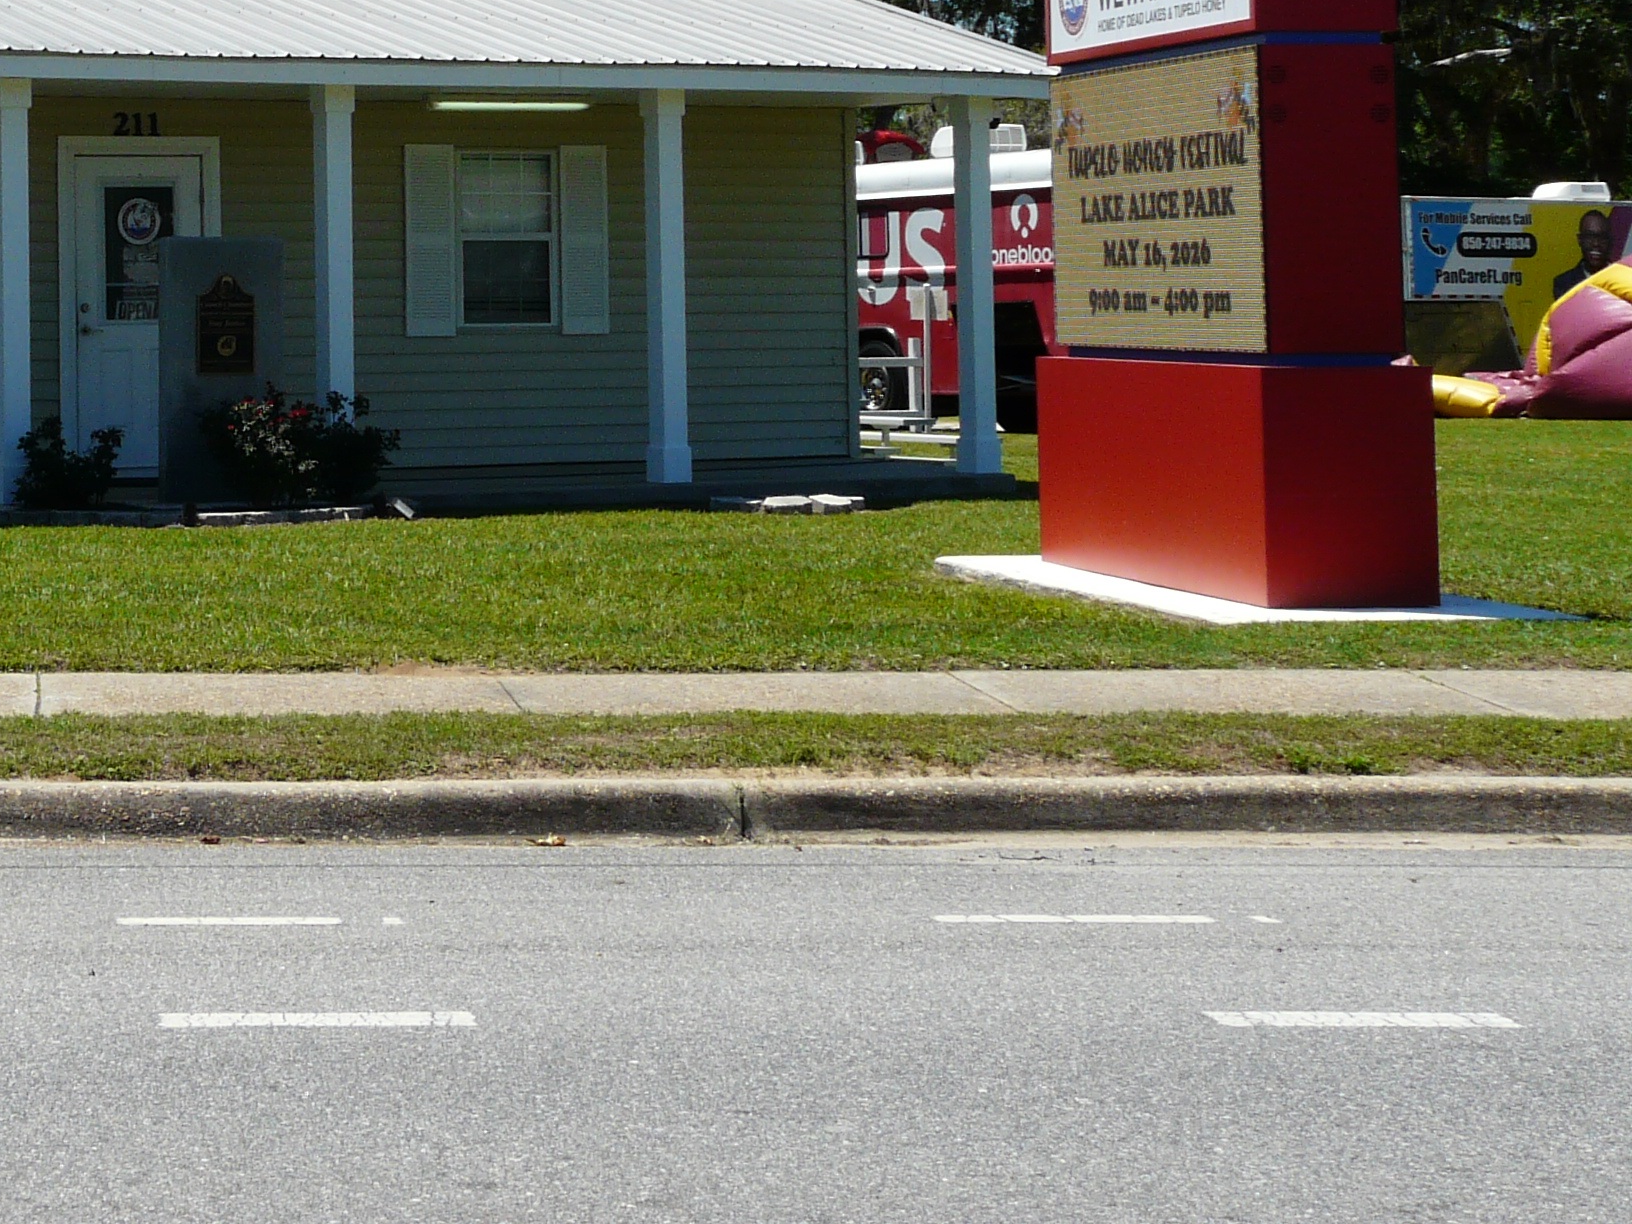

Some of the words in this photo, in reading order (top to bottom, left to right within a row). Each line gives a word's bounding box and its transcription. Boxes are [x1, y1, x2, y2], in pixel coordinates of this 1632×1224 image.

[1097, 17, 1116, 32] HOME
[1118, 16, 1125, 30] OF
[1127, 13, 1144, 28] DEAD
[1145, 8, 1166, 24] LAKES
[1174, 2, 1201, 18] TUPELO
[112, 111, 160, 136] 211
[1068, 143, 1119, 179] TUPELO
[1123, 136, 1176, 174] HONEY
[1180, 129, 1248, 169] FESTIVAL
[1080, 192, 1125, 223] LAKE
[1127, 190, 1180, 221] ALICE
[1183, 185, 1236, 218] PARK
[1418, 212, 1433, 224] For
[1435, 212, 1468, 224] Mobile
[1470, 212, 1511, 225] Services
[1513, 213, 1532, 225] Call
[992, 244, 1054, 264] onebloo
[1103, 239, 1139, 266] MAY
[1144, 240, 1167, 272] 16,
[1170, 238, 1211, 266] 2026
[1436, 268, 1523, 286] PanCareFL.org
[1089, 288, 1119, 316] 9:00
[1123, 291, 1148, 312] am
[1164, 287, 1199, 316] 4:00
[1203, 291, 1232, 318] pm
